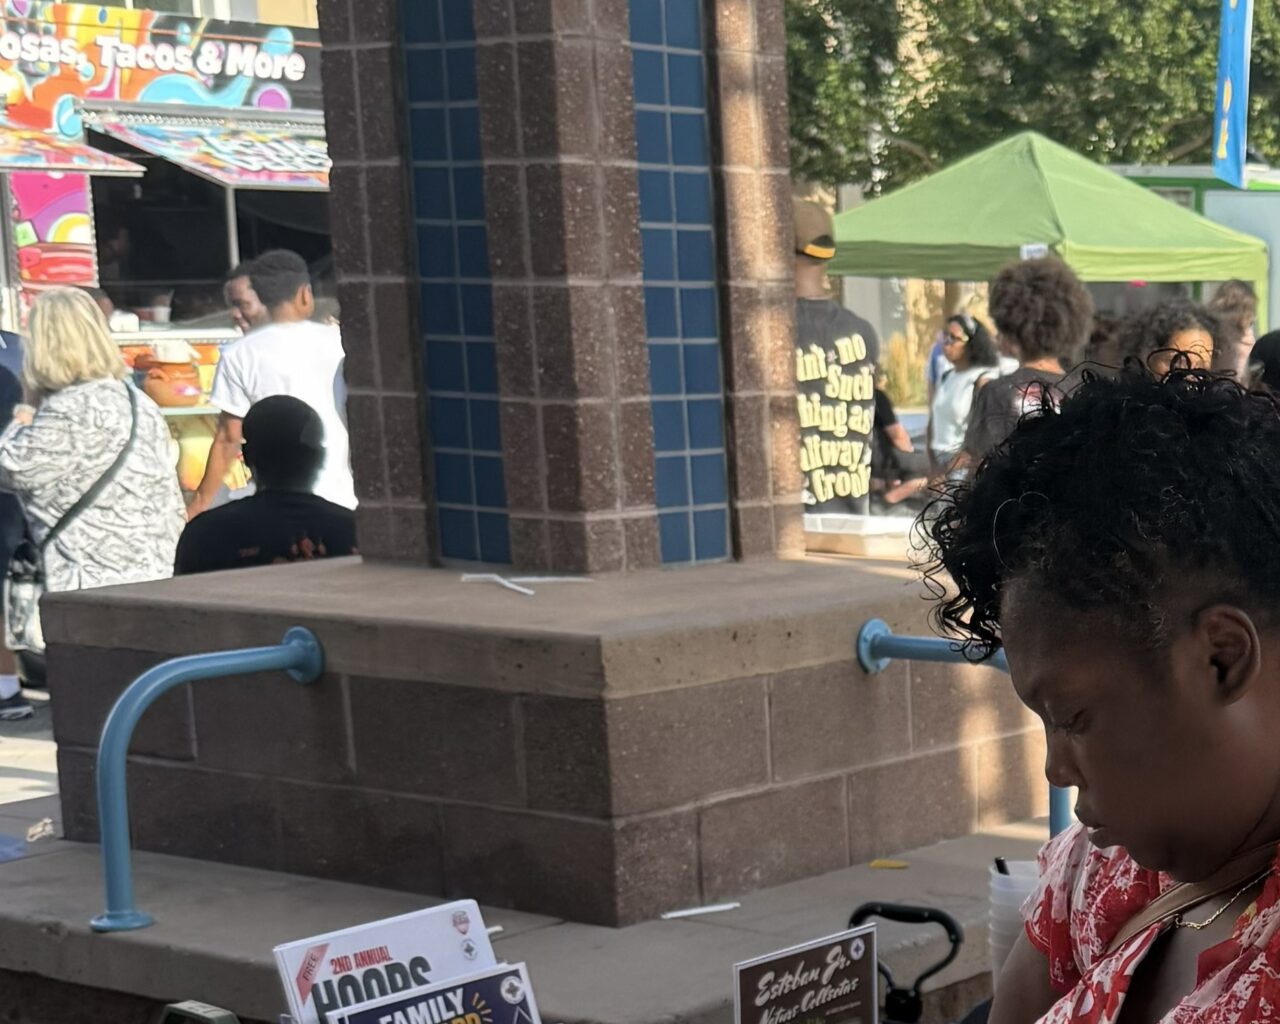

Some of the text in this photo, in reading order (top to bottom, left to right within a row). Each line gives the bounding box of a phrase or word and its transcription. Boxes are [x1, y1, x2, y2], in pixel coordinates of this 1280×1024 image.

[97, 35, 192, 72] Tacos
[196, 42, 223, 74] &
[226, 43, 306, 80] More
[835, 334, 866, 365] no
[825, 364, 873, 400] Such
[330, 945, 392, 975] 2ND ANNUAL
[755, 945, 851, 1006] Esteban Jr.
